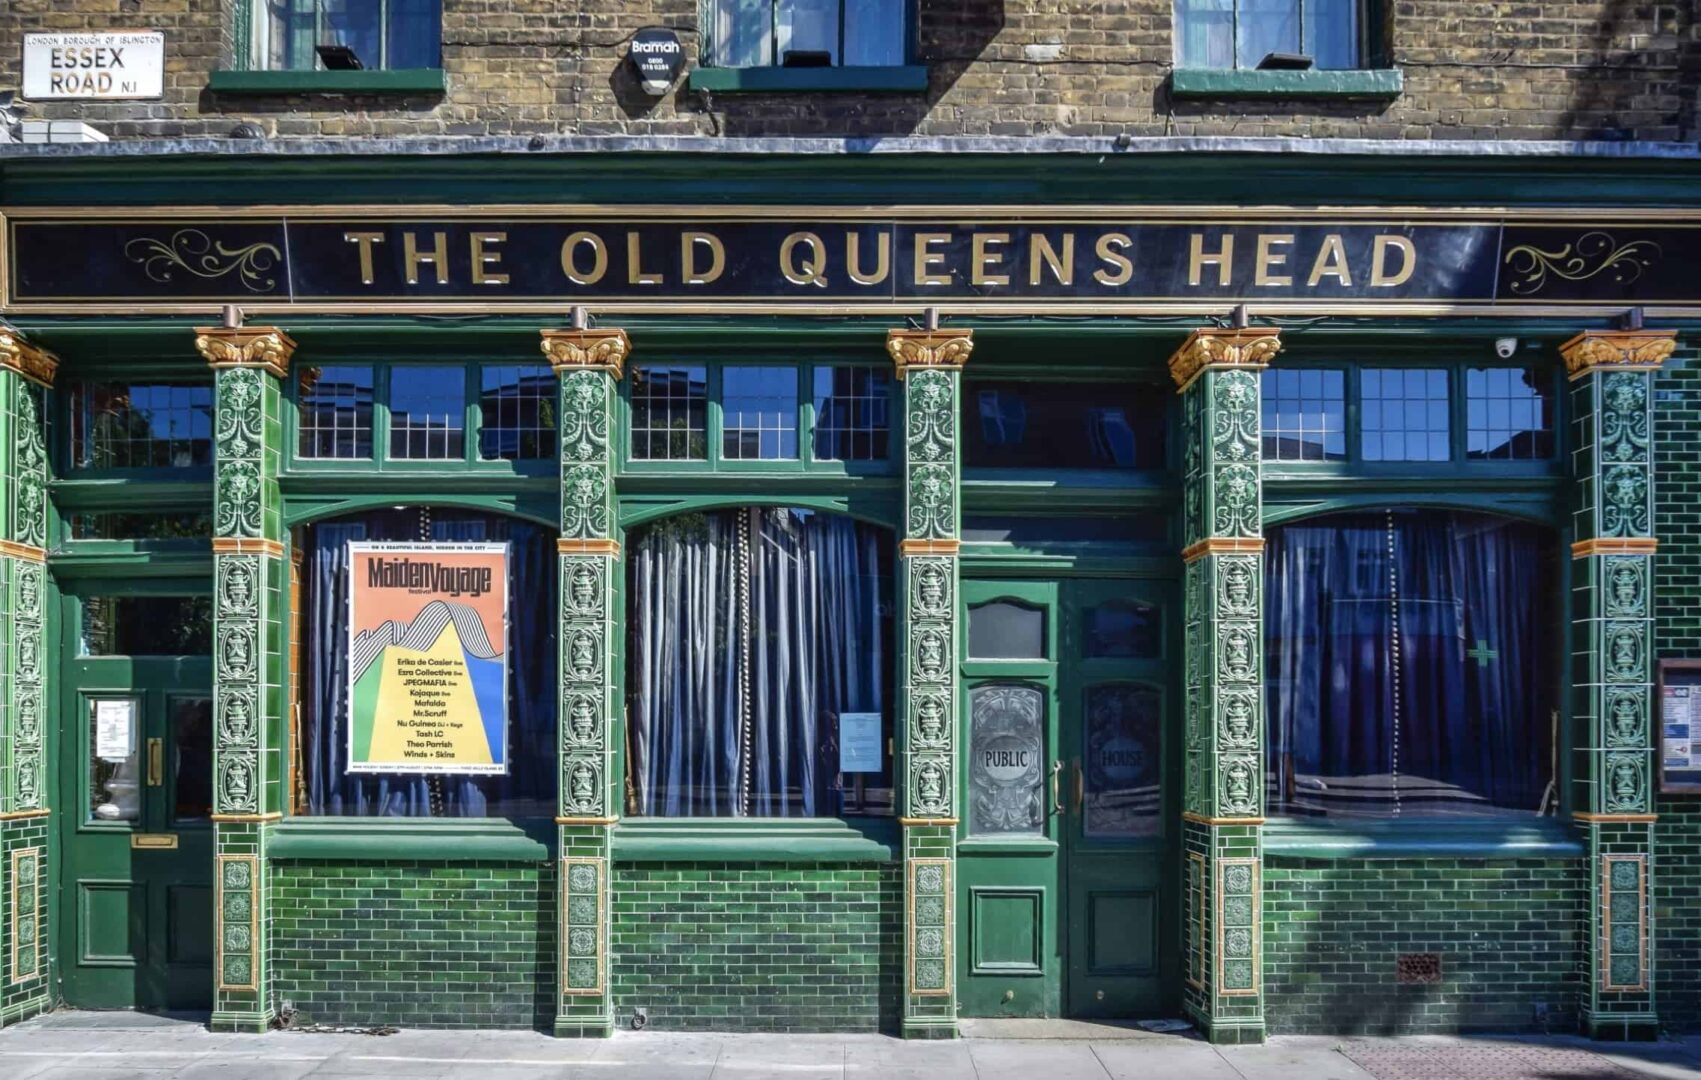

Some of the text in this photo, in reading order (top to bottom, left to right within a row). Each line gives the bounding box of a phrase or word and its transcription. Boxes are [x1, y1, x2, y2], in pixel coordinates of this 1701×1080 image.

[64, 37, 100, 45] BOROUGH
[105, 37, 114, 45] OF
[120, 36, 161, 44] ISLINGTON
[632, 41, 680, 53] Bramah
[51, 48, 124, 68] ESSEX
[50, 72, 112, 93] ROAD
[344, 231, 1416, 287] THE OLD QUEENS HEAD
[434, 730, 444, 738] LC
[407, 740, 453, 748] Theo Parrish
[985, 751, 1028, 768] PUBLIC
[1102, 750, 1144, 767] HOUSE
